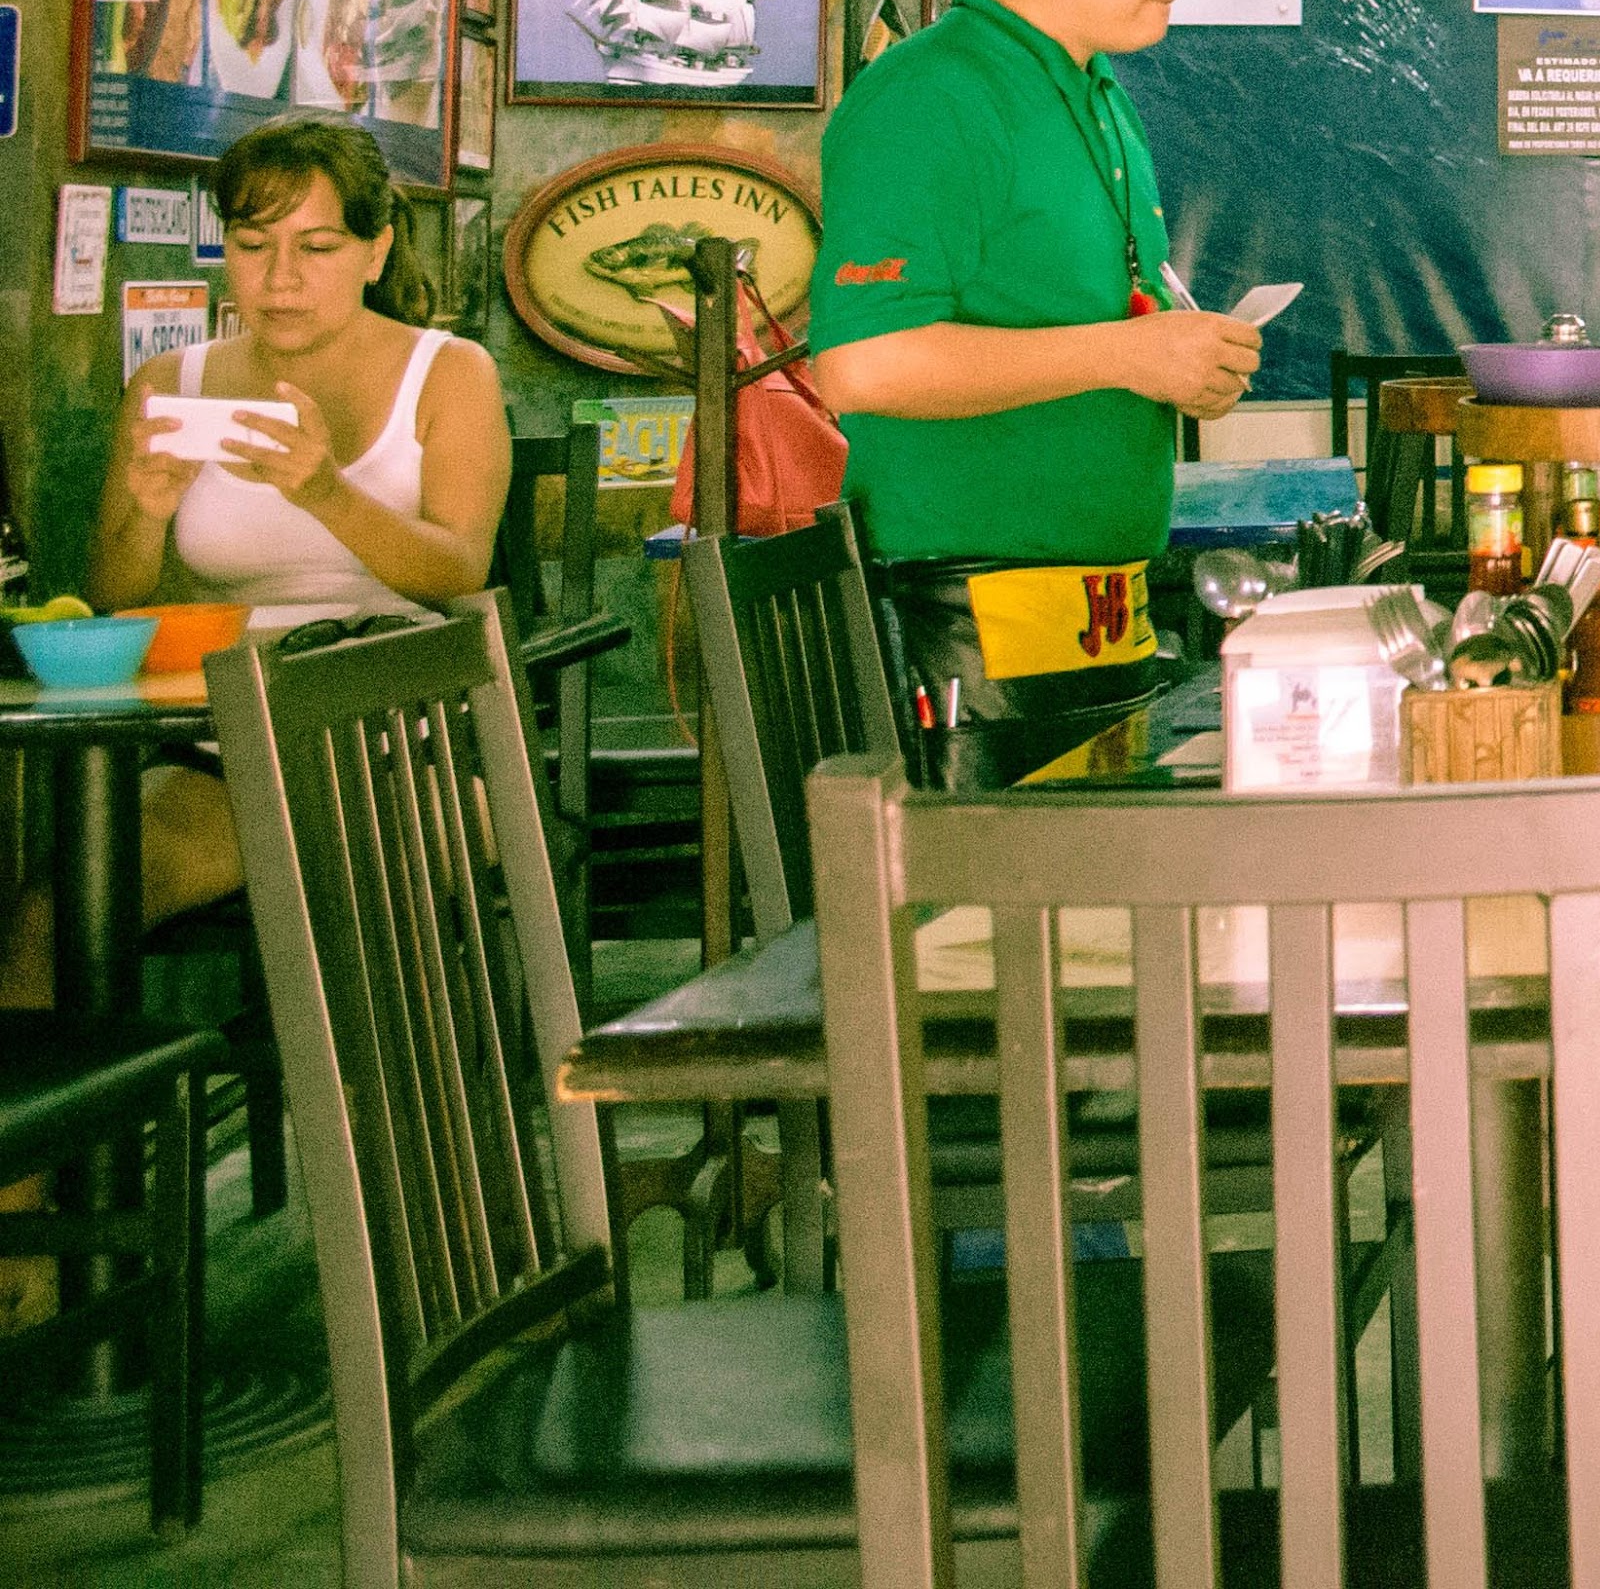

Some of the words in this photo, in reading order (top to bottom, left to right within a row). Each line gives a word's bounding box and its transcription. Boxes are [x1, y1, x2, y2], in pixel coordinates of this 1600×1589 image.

[1518, 68, 1532, 82] VA
[1535, 69, 1544, 82] A
[1536, 57, 1598, 65] ESTIMADO
[547, 184, 618, 239] FISH
[628, 175, 726, 204] TALES
[733, 183, 791, 225] INN
[598, 418, 670, 463] EACH
